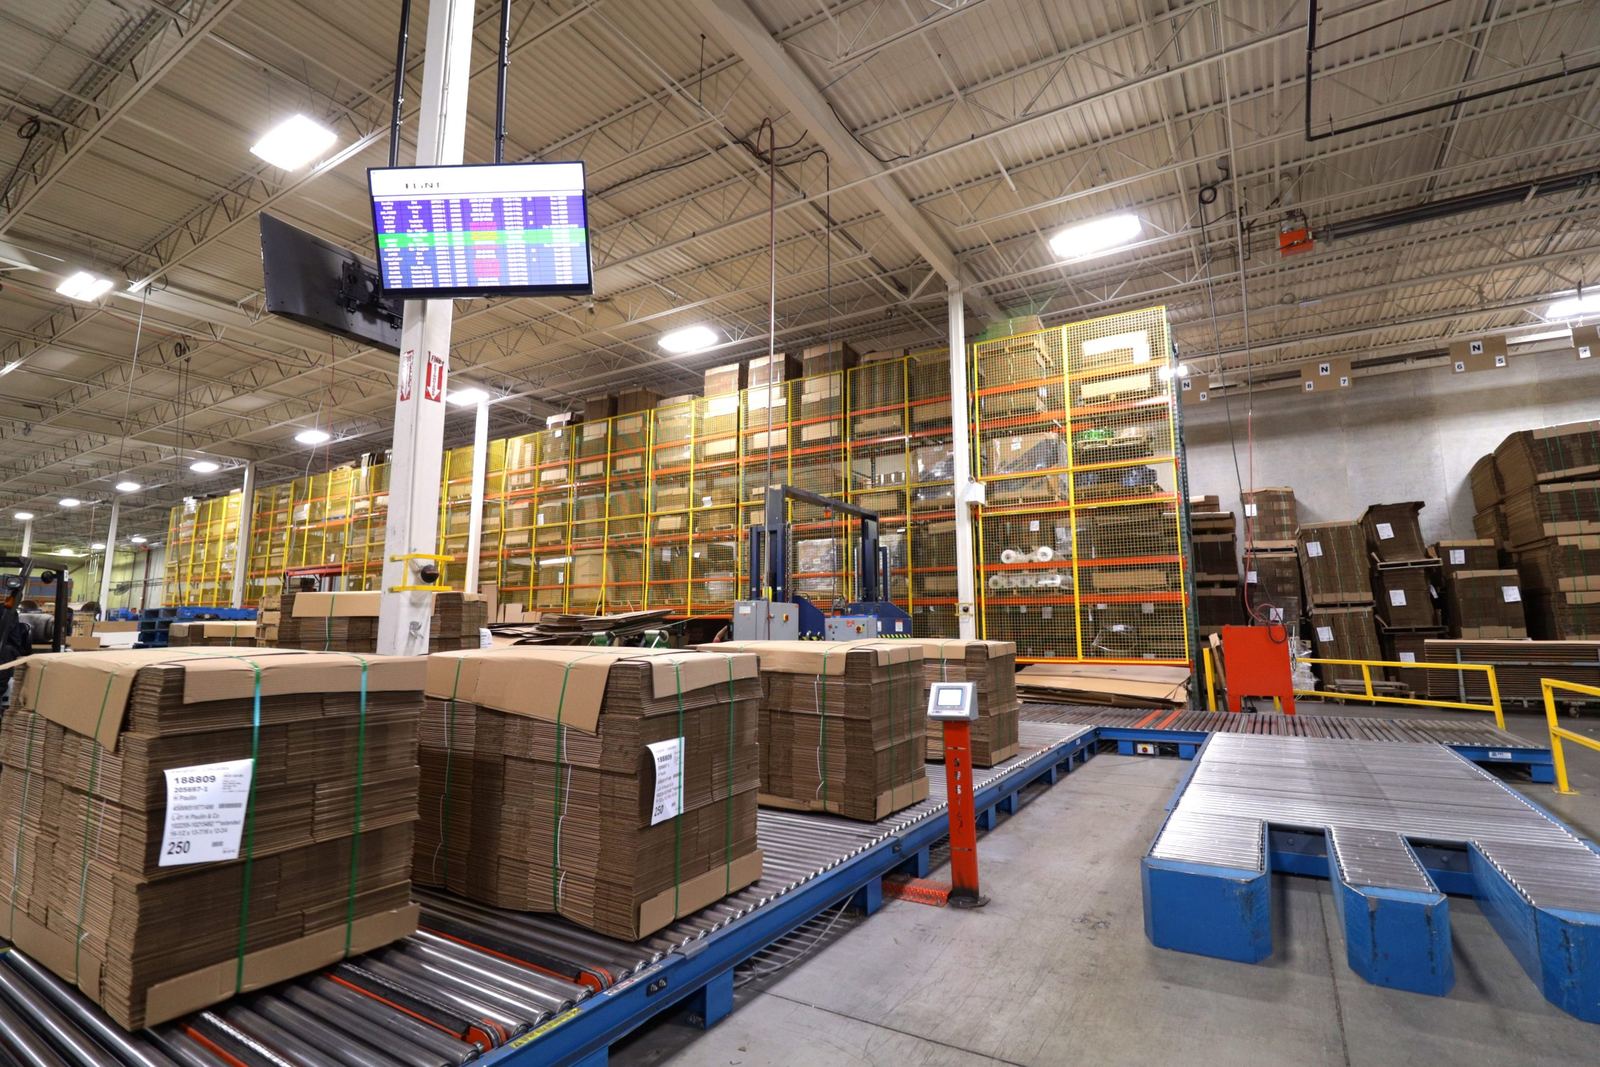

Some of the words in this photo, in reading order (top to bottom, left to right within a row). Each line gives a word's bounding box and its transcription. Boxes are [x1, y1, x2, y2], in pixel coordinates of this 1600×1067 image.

[1472, 344, 1481, 352] N
[174, 775, 216, 784] 188809
[653, 804, 664, 817] 250
[167, 840, 190, 855] 250
